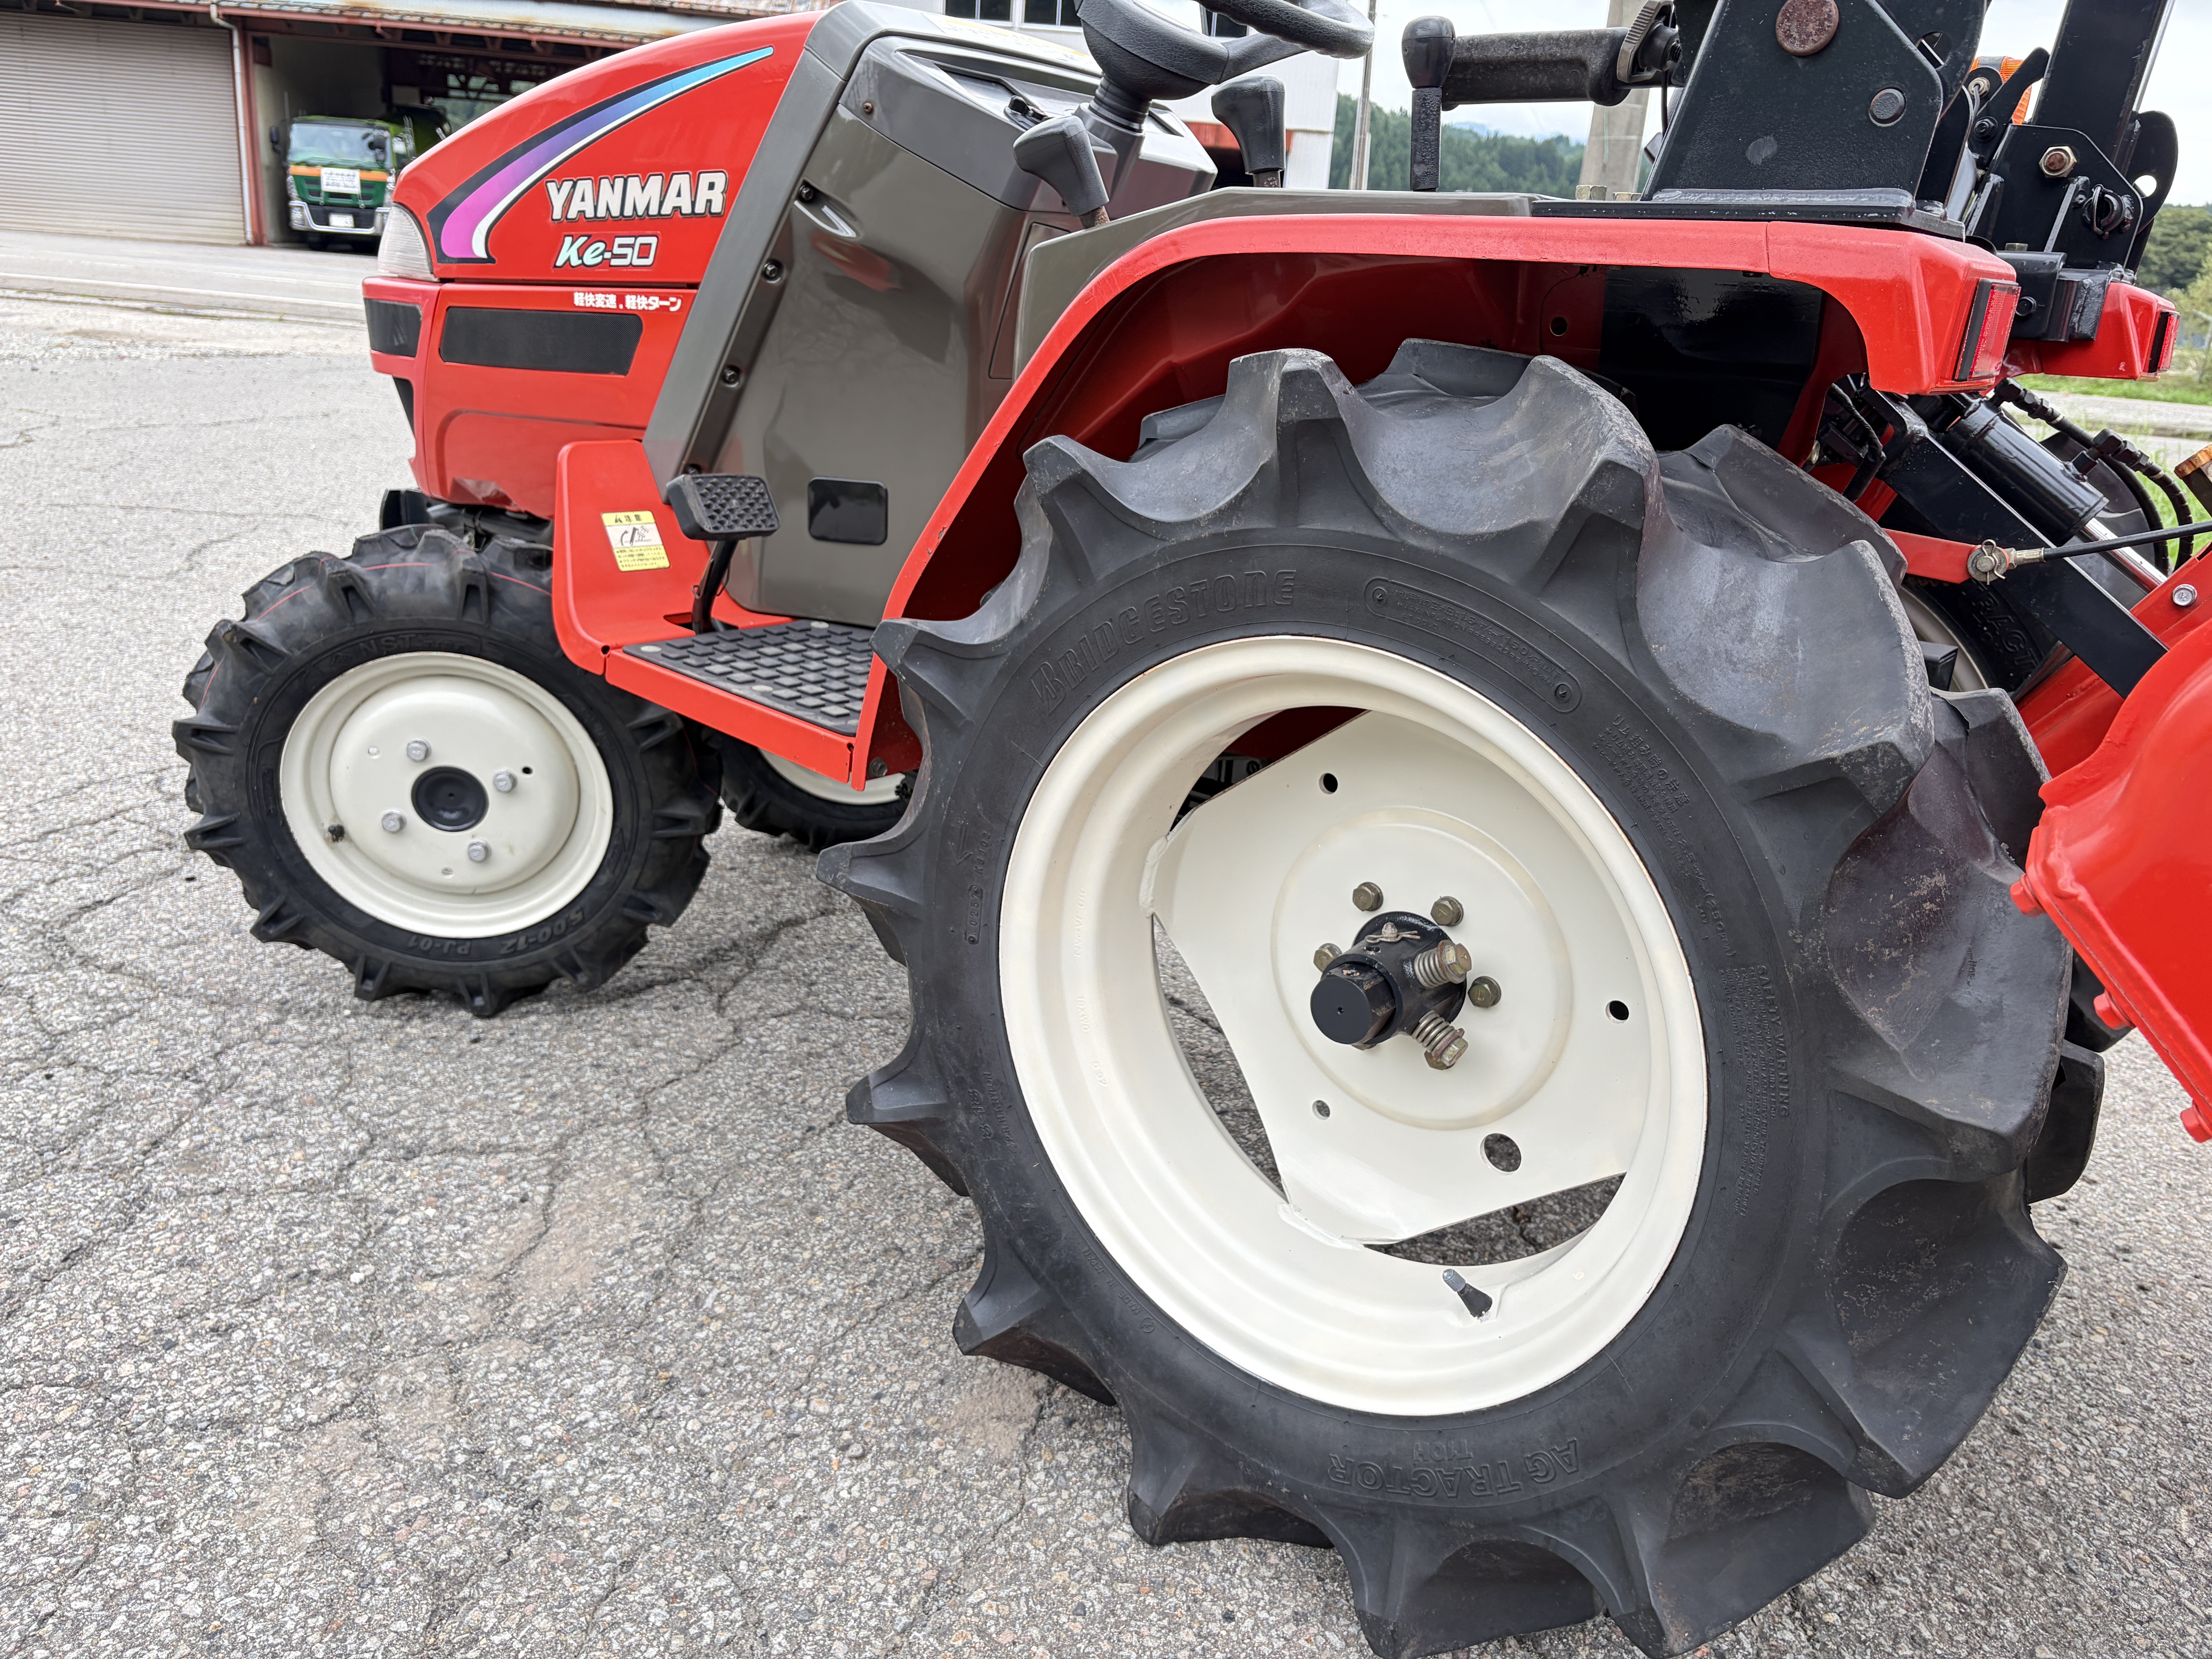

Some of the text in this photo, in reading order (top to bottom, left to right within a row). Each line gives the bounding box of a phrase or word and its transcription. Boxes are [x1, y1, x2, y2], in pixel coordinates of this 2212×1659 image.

[545, 169, 729, 222] YANMAR
[553, 234, 659, 268] Ke-50
[1415, 616, 1439, 630] COLD
[1421, 609, 1467, 632] INFLATION
[1030, 569, 1297, 715] BRIDGESTONE
[407, 938, 472, 955] PJ-01
[1759, 1004, 1770, 1034] INJURY
[1756, 964, 1789, 1118] SAFETY WARNING
[983, 1072, 999, 1104] NYLON
[969, 1089, 994, 1140] 8-18
[1082, 1249, 1143, 1316] MADE IN JAPAN
[1328, 1437, 1580, 1498] AG TRACTOR
